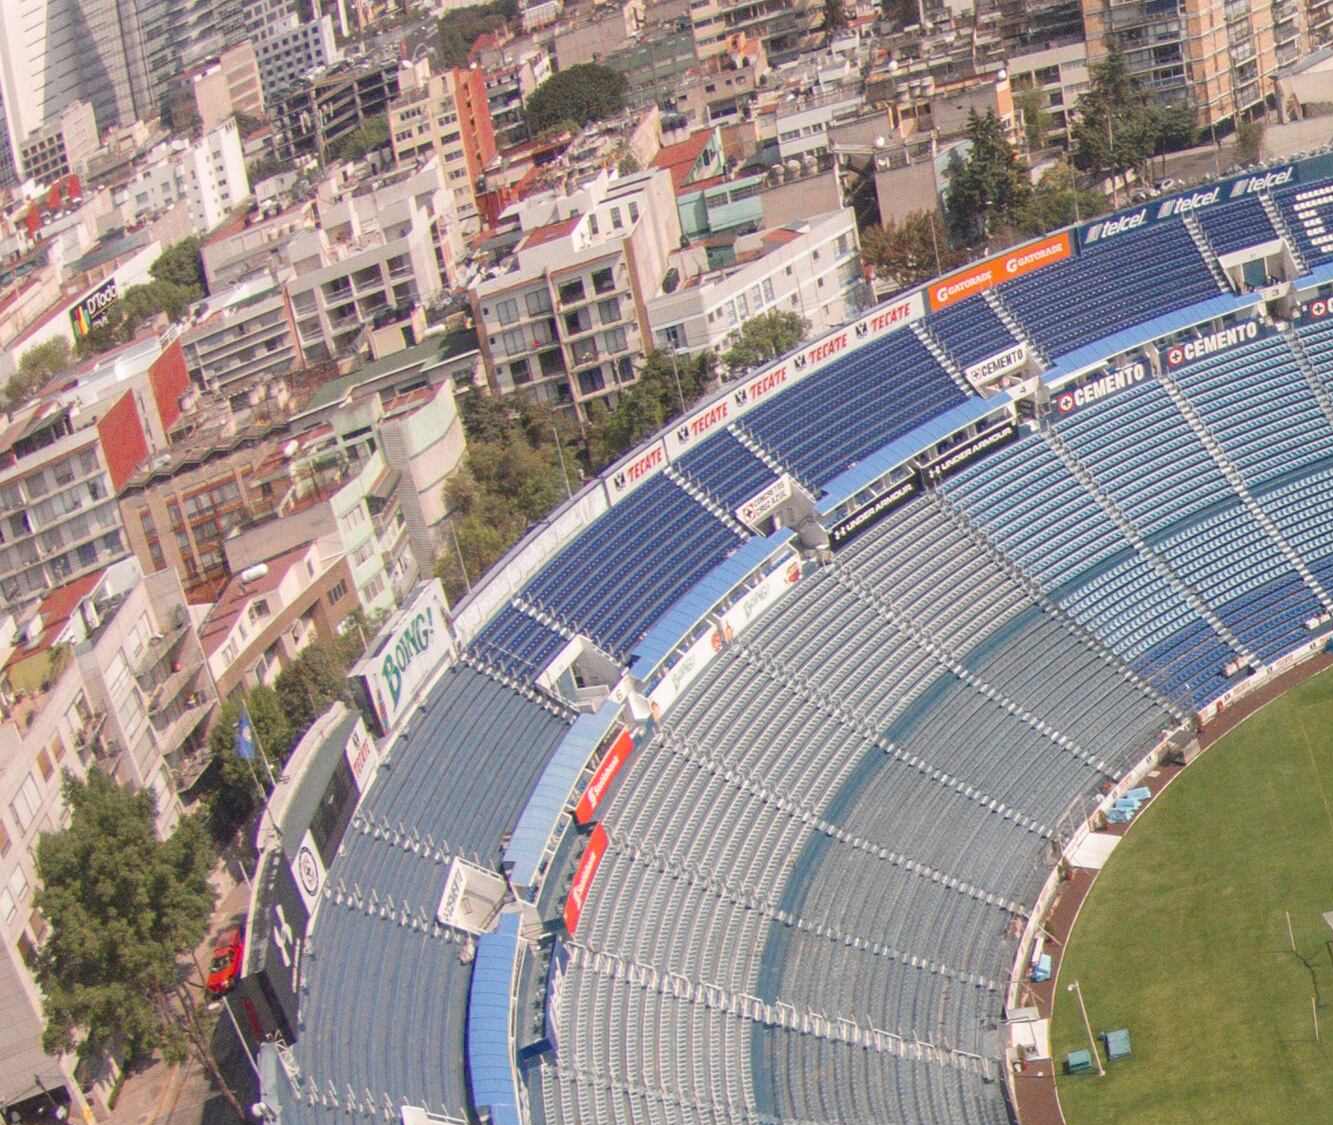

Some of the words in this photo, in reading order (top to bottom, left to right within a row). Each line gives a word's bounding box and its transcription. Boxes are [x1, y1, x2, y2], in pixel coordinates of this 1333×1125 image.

[1246, 167, 1294, 194] telcel
[1173, 187, 1220, 214] telcel
[1101, 208, 1148, 240] telcel
[1017, 243, 1064, 268] GATORADE
[948, 270, 993, 297] GATORADE
[871, 302, 911, 332] TECATE
[809, 333, 848, 365] TECATE
[1184, 321, 1258, 362] CEMENTO
[980, 348, 1025, 378] CEMENTO
[750, 367, 787, 400] TECATE
[1074, 363, 1145, 408] CEMENTO
[691, 402, 728, 437] TECATE
[628, 447, 662, 482] TECATE
[941, 448, 972, 471] UNDER
[972, 426, 1012, 455] ARMOUR
[382, 607, 435, 713] BOING!
